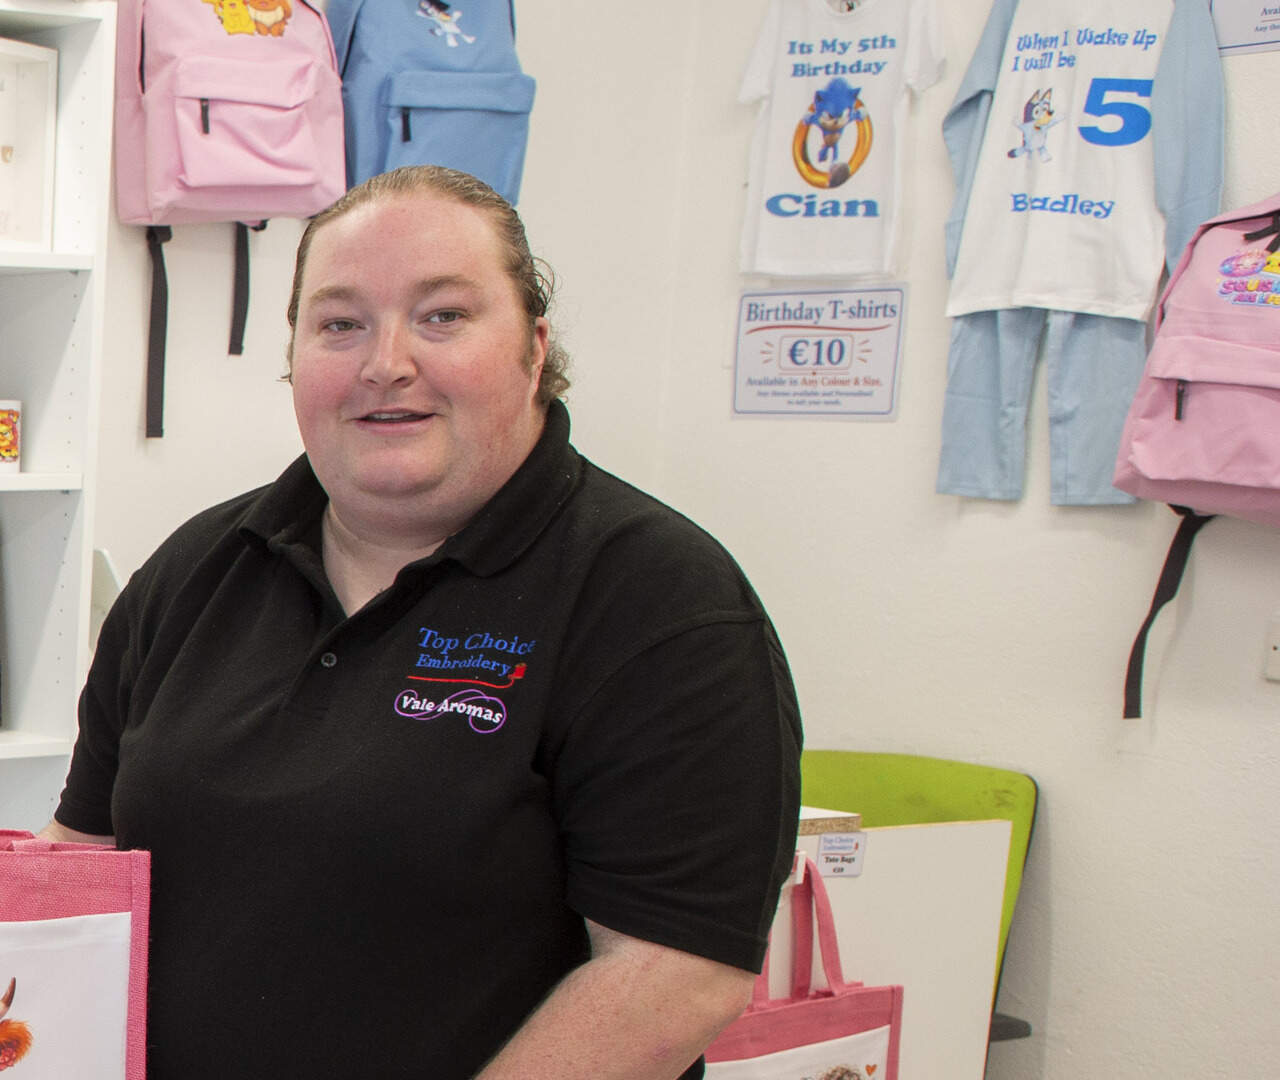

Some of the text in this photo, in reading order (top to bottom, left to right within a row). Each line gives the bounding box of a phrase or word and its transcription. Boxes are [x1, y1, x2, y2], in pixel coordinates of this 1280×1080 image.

[787, 35, 896, 55] Its My 5th
[1017, 28, 1158, 51] When I Wake Up
[791, 60, 888, 77] Birthday
[1012, 51, 1076, 72] I will be
[1078, 77, 1155, 147] 5
[766, 194, 880, 218] Cian
[1010, 193, 1115, 219] Badley
[746, 299, 897, 325] Birthday T-shirts
[788, 338, 845, 366] €10
[746, 377, 787, 387] Available
[800, 377, 818, 388] Any
[821, 376, 850, 386] Colour
[418, 627, 536, 655] Top Choice
[416, 653, 511, 677] Embroidery
[401, 695, 503, 724] Vale Aromas
